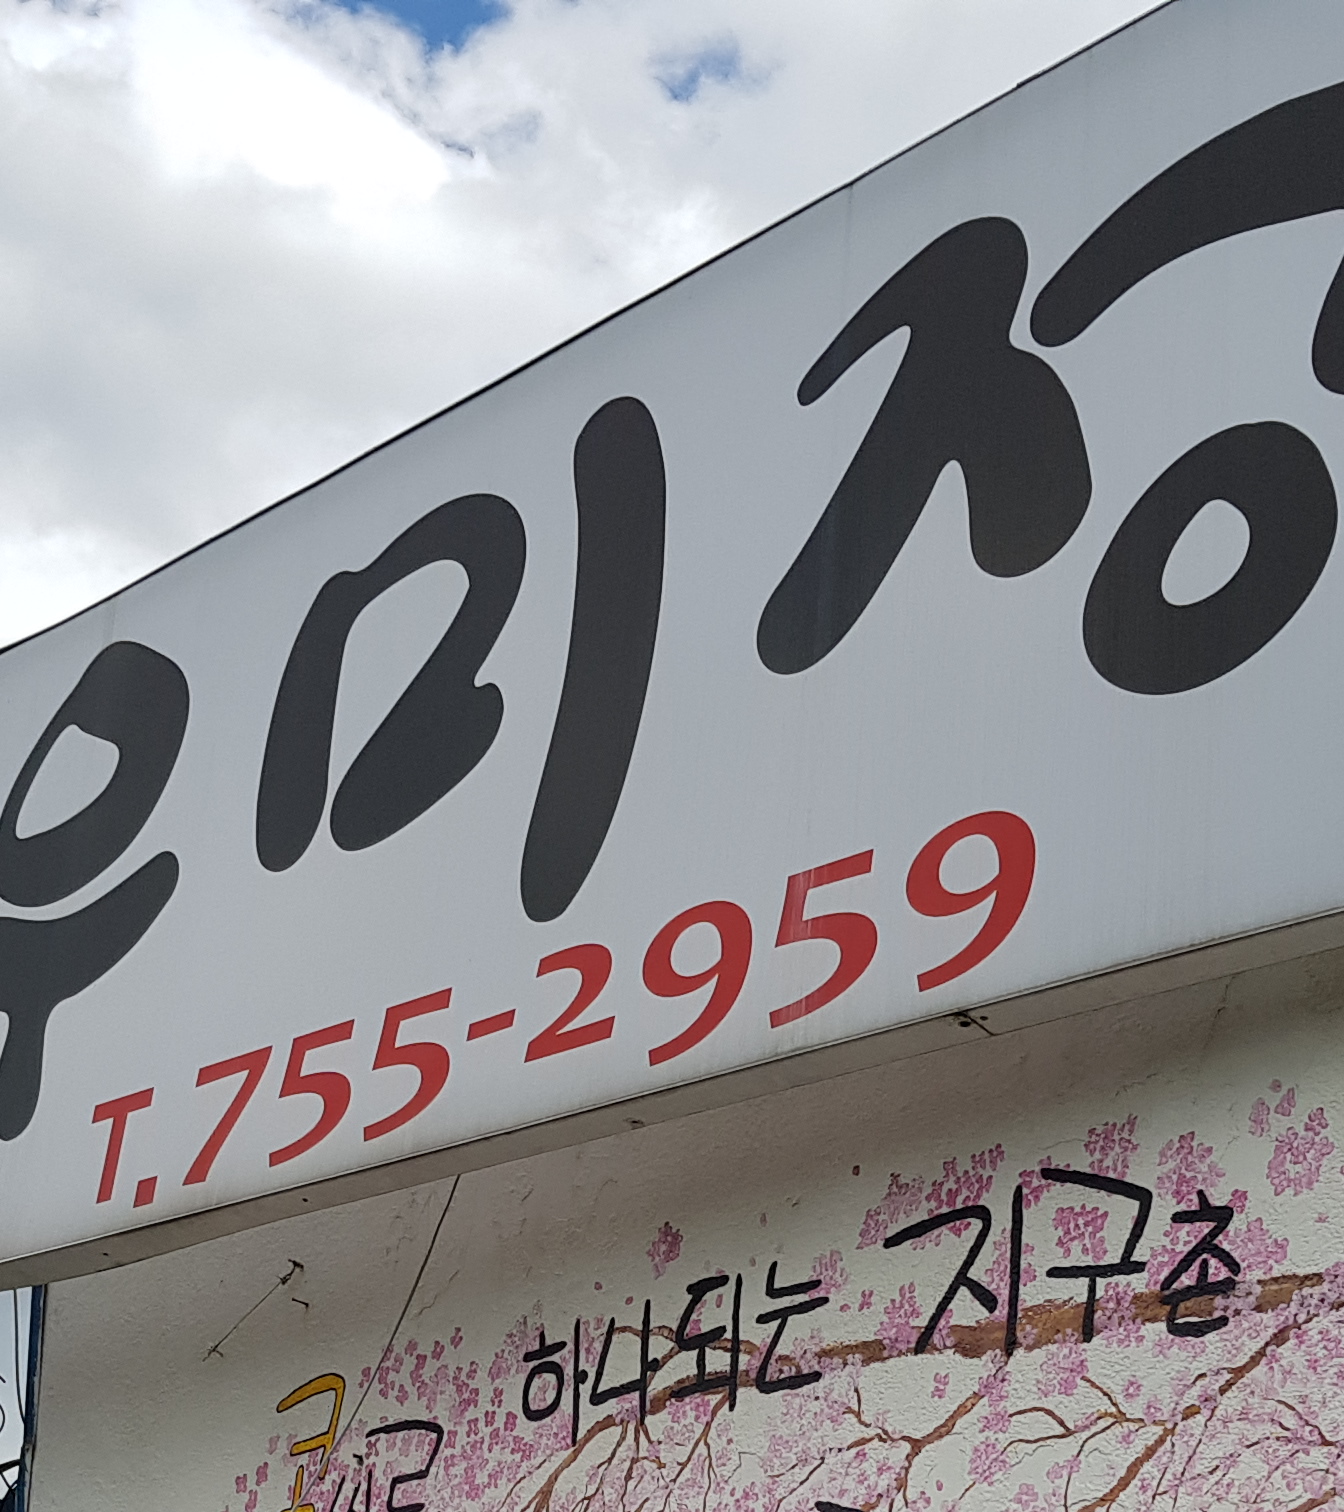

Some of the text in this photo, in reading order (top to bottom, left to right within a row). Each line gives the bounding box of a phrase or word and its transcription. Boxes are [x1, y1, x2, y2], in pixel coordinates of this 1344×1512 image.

[90, 810, 1036, 1207] T.755-2959
[520, 1260, 832, 1446] 하나되는
[882, 1166, 1242, 1358] 지구촌
